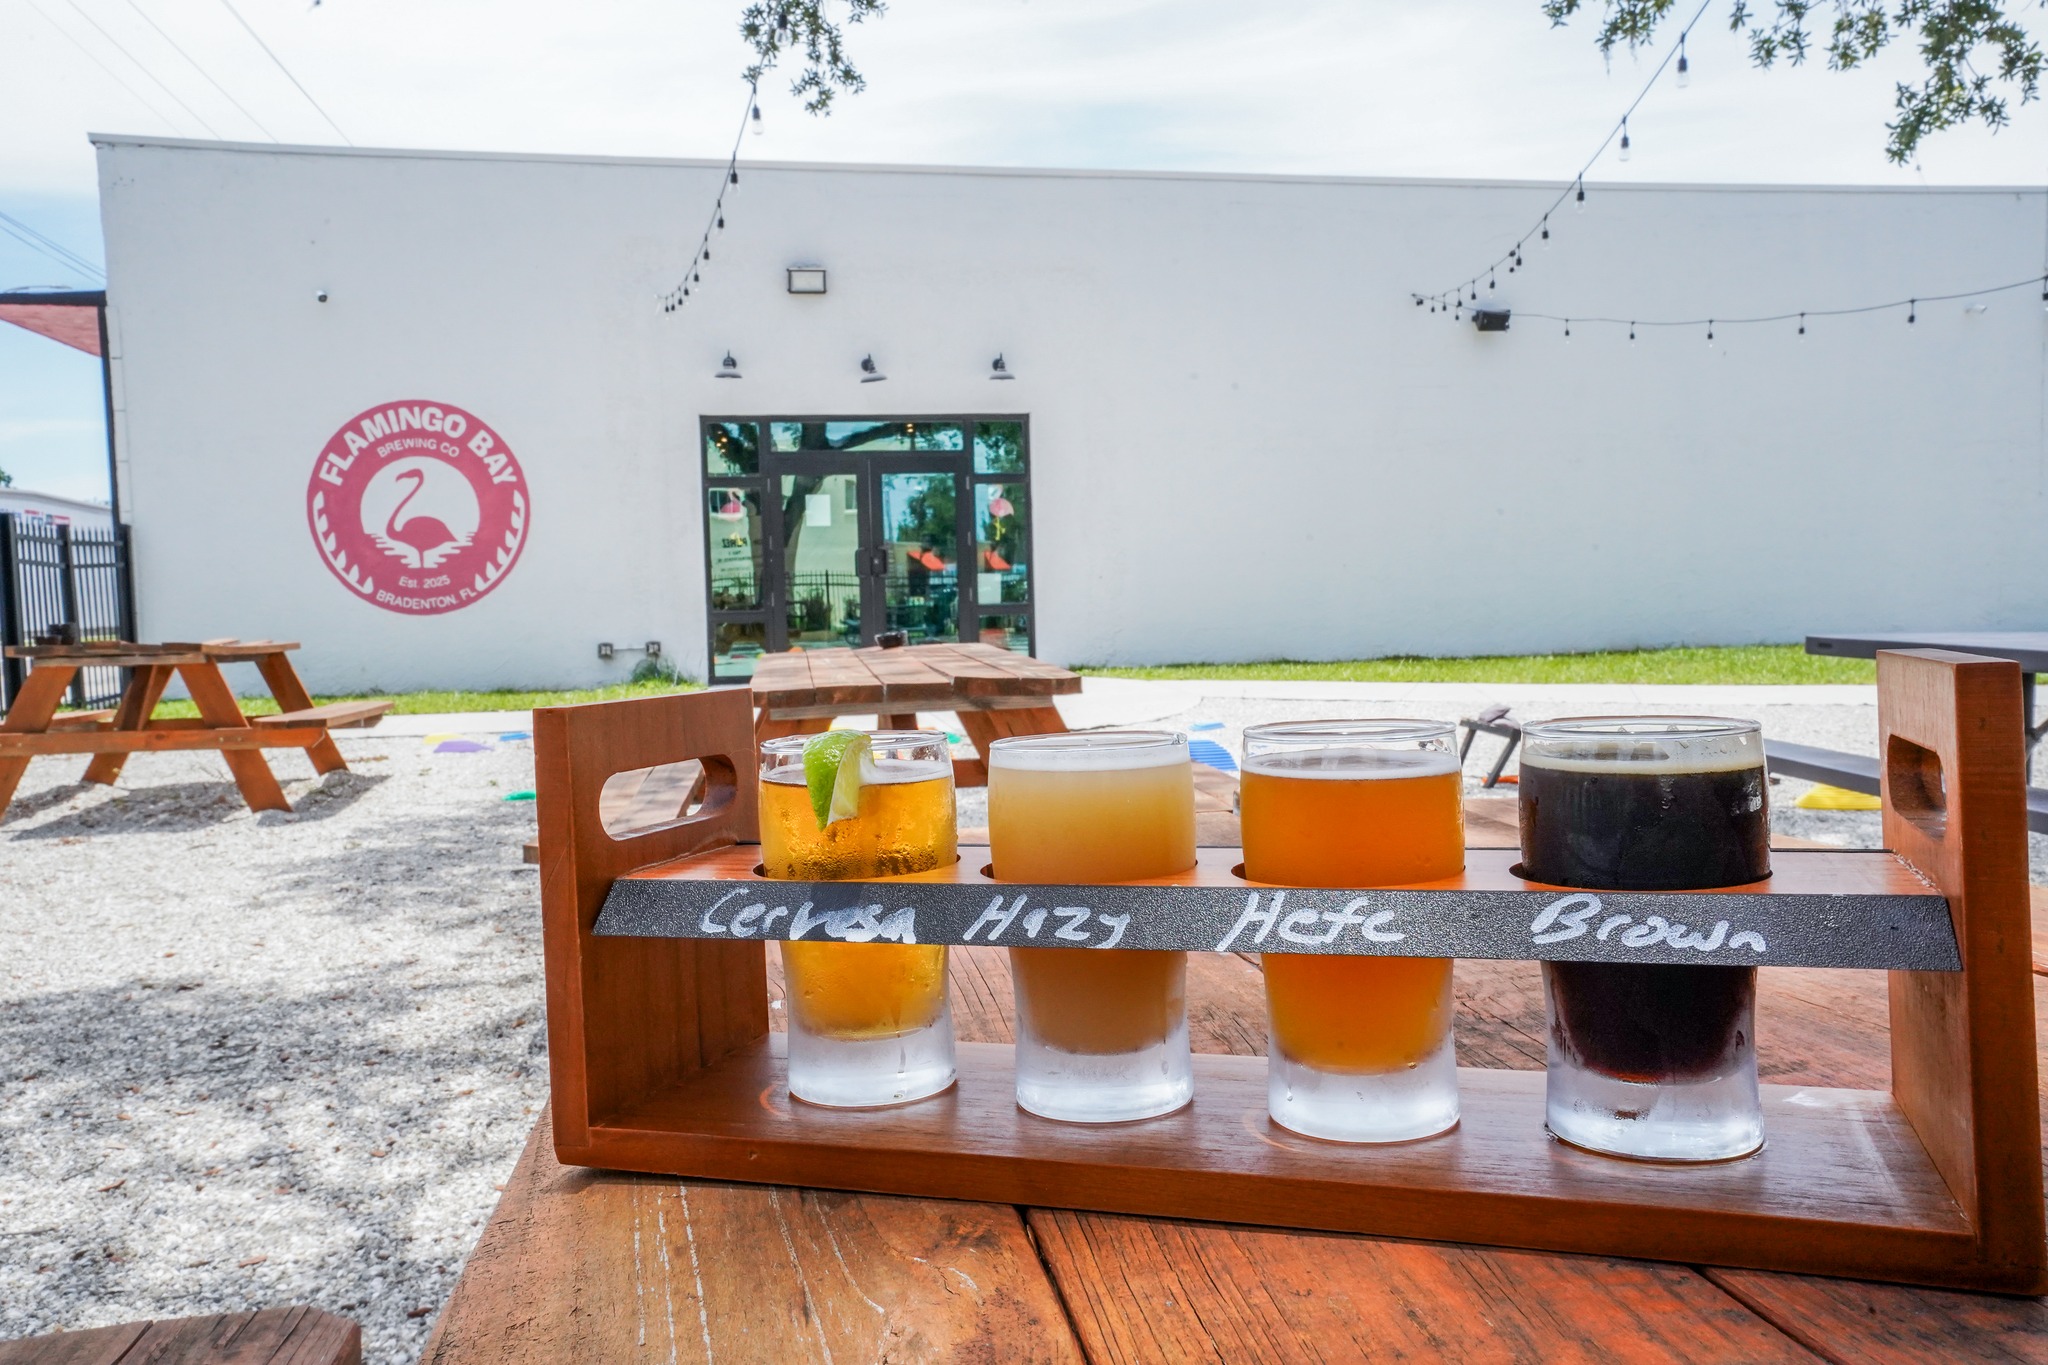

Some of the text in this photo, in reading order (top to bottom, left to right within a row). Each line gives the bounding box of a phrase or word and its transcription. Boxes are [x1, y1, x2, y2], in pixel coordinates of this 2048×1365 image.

[319, 406, 517, 486] FLAMINGO BAY
[376, 437, 460, 458] BREWING CO
[423, 575, 451, 589] 2025
[459, 587, 477, 601] FL
[962, 893, 1131, 949] Hazy
[1216, 892, 1406, 952] Hefe
[1530, 893, 1767, 953] Brown
